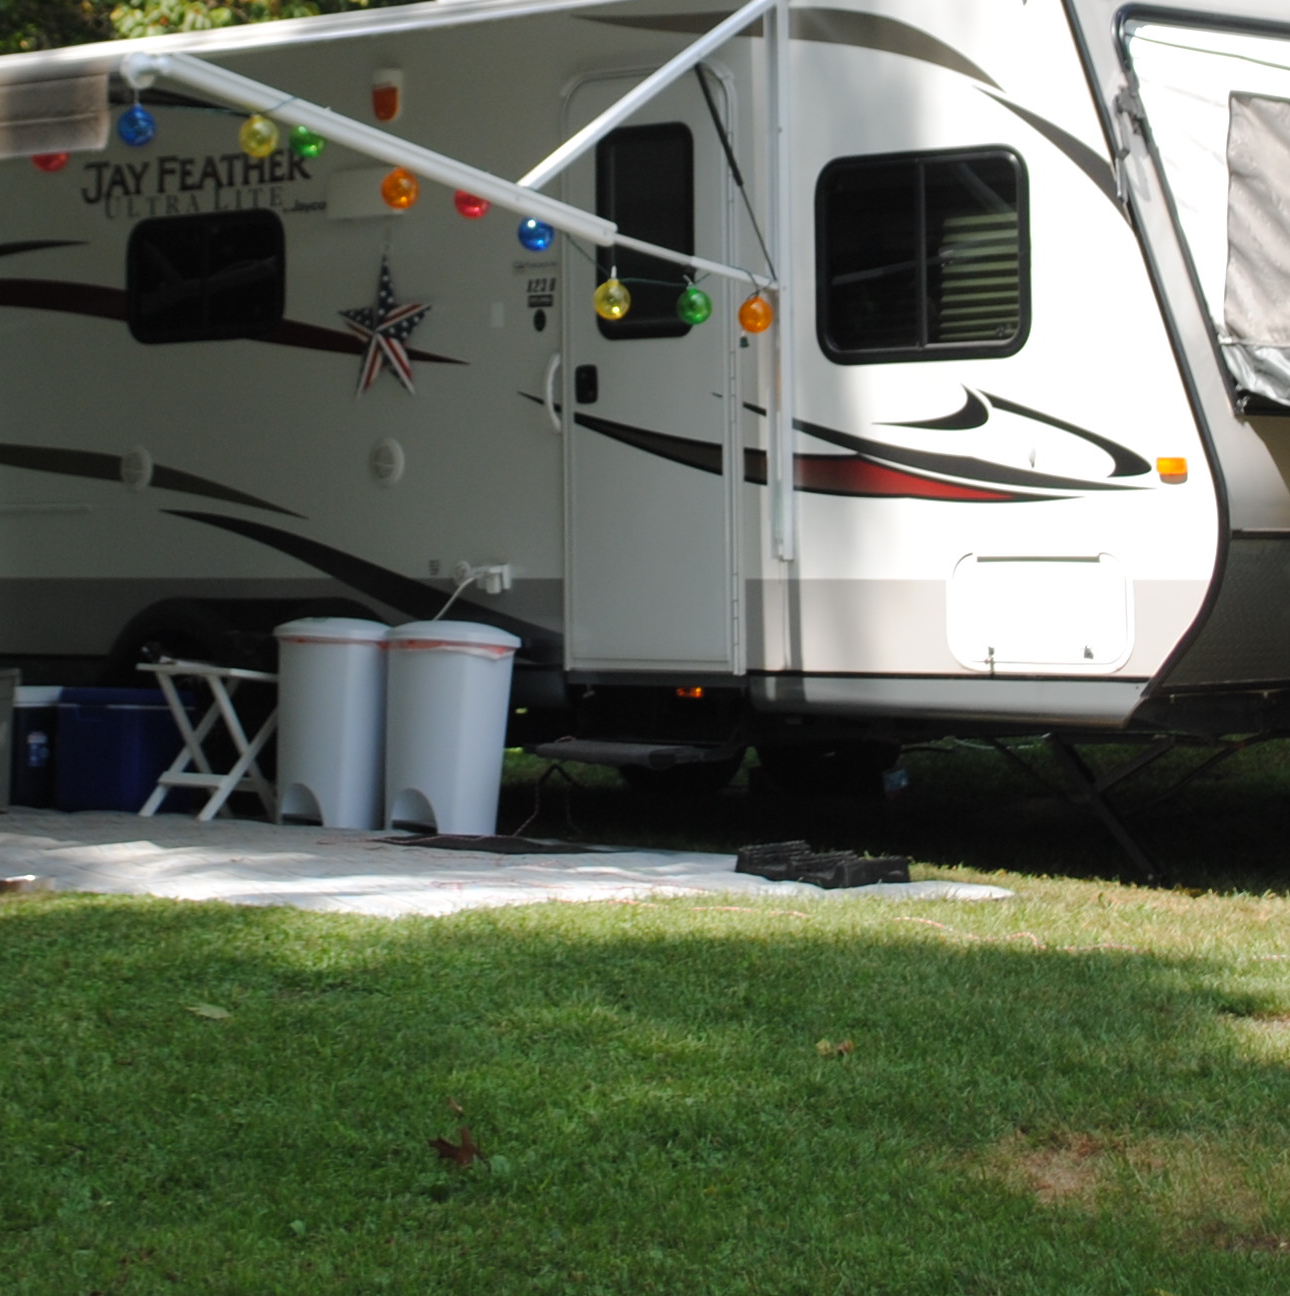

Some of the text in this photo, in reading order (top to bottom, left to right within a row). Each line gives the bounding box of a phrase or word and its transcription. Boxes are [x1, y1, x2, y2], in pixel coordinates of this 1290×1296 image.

[82, 148, 312, 204] JAY FEATHER
[105, 185, 283, 219] ULTRA LITE
